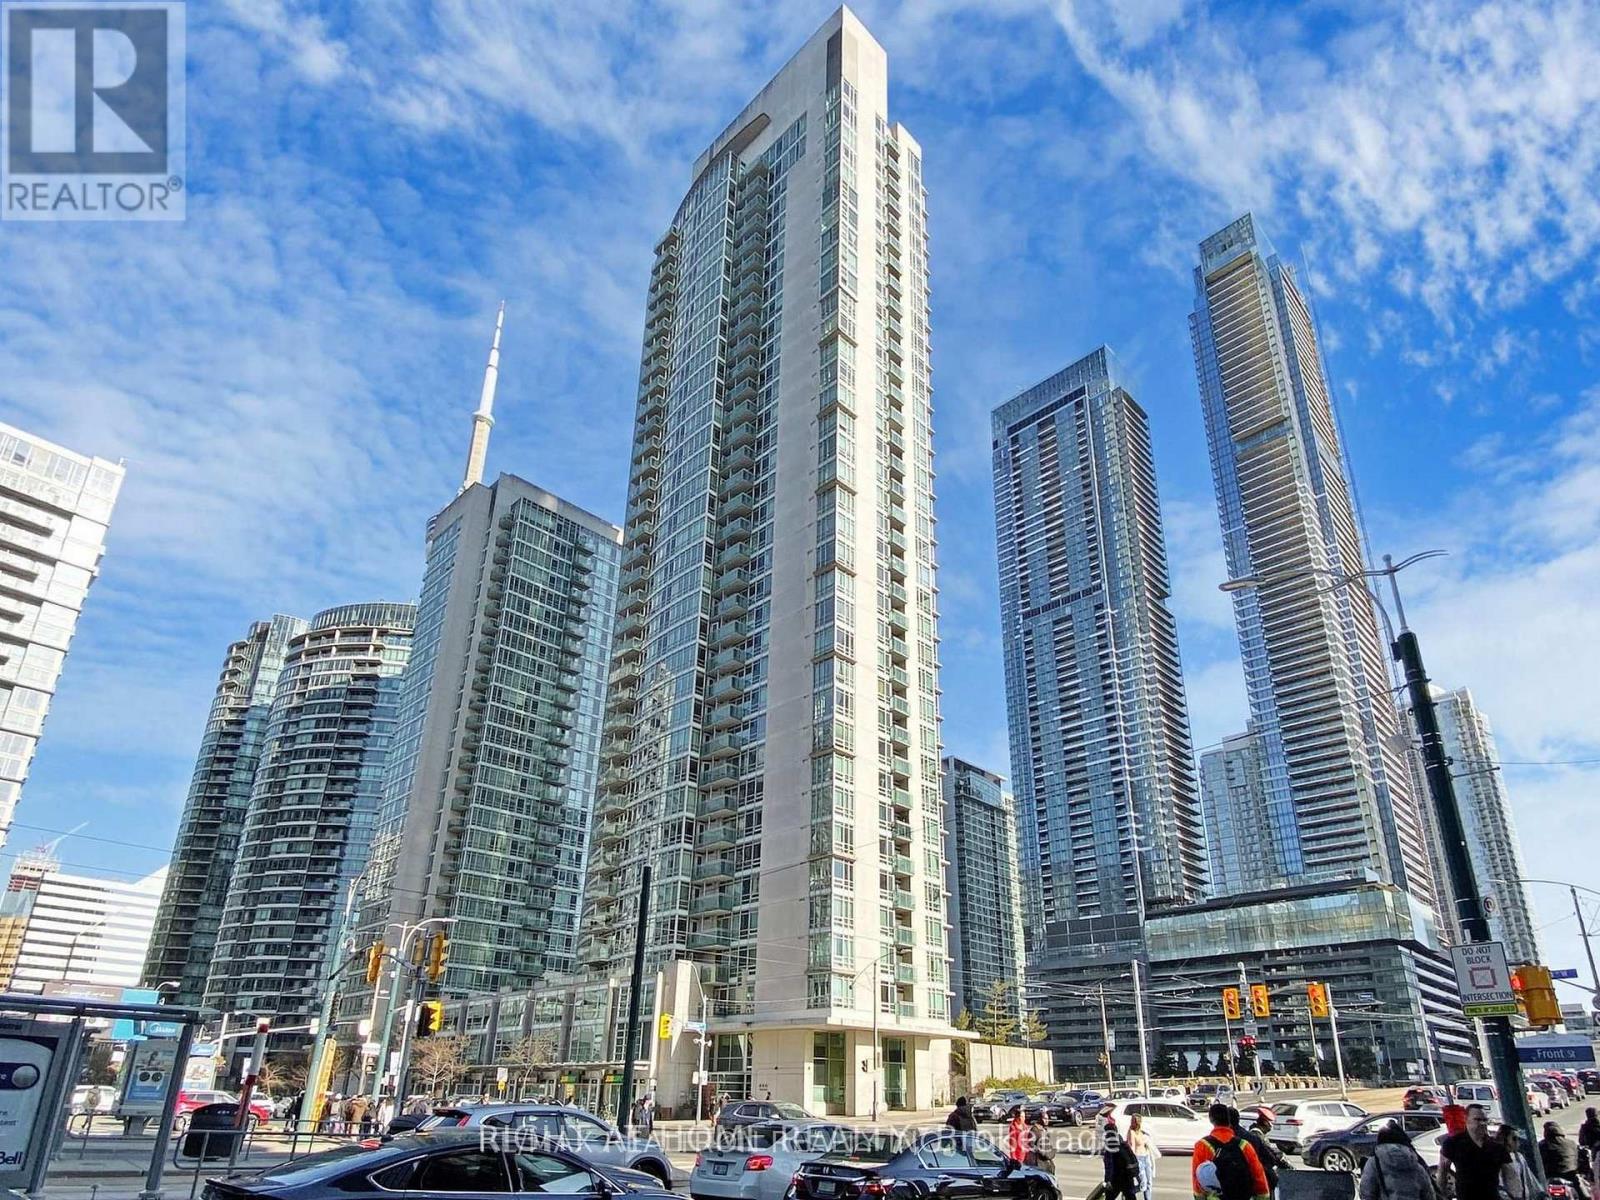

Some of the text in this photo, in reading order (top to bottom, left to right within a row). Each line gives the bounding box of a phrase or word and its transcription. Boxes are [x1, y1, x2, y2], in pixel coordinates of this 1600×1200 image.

[1462, 946, 1491, 955] DO NOT
[1466, 956, 1491, 965] BLOCK
[1462, 992, 1514, 1001] INTERSECTION
[1537, 1049, 1564, 1059] Front
[0, 1151, 23, 1165] Bell
